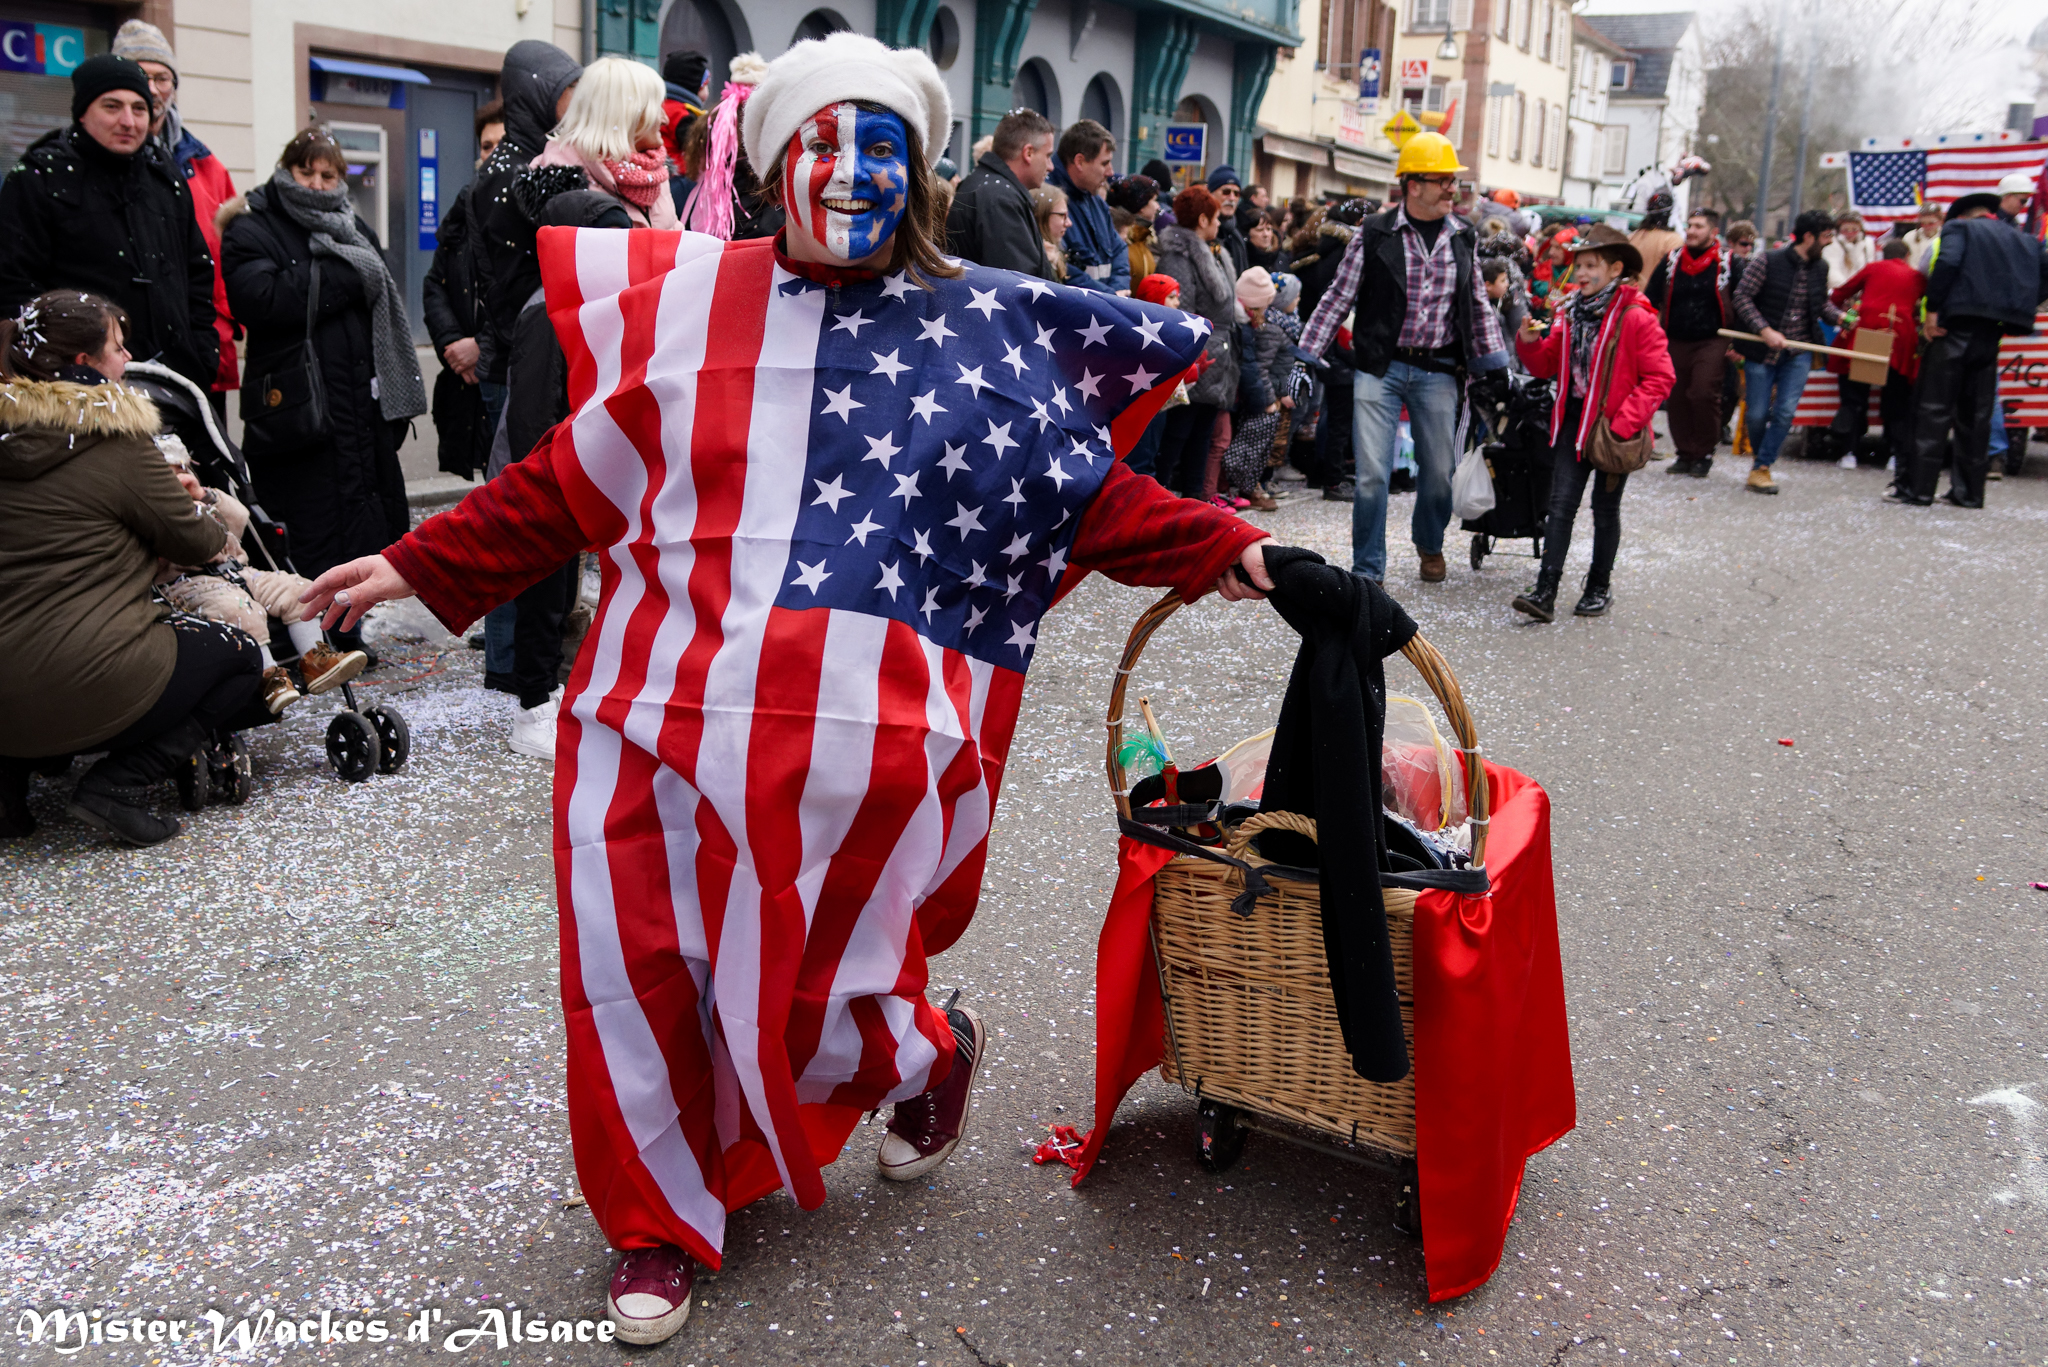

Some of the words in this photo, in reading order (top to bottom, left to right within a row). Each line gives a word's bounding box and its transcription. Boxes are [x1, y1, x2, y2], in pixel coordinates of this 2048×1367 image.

[3, 29, 77, 68] CIC
[1168, 133, 1199, 145] LCL
[1999, 353, 2048, 388] AG
